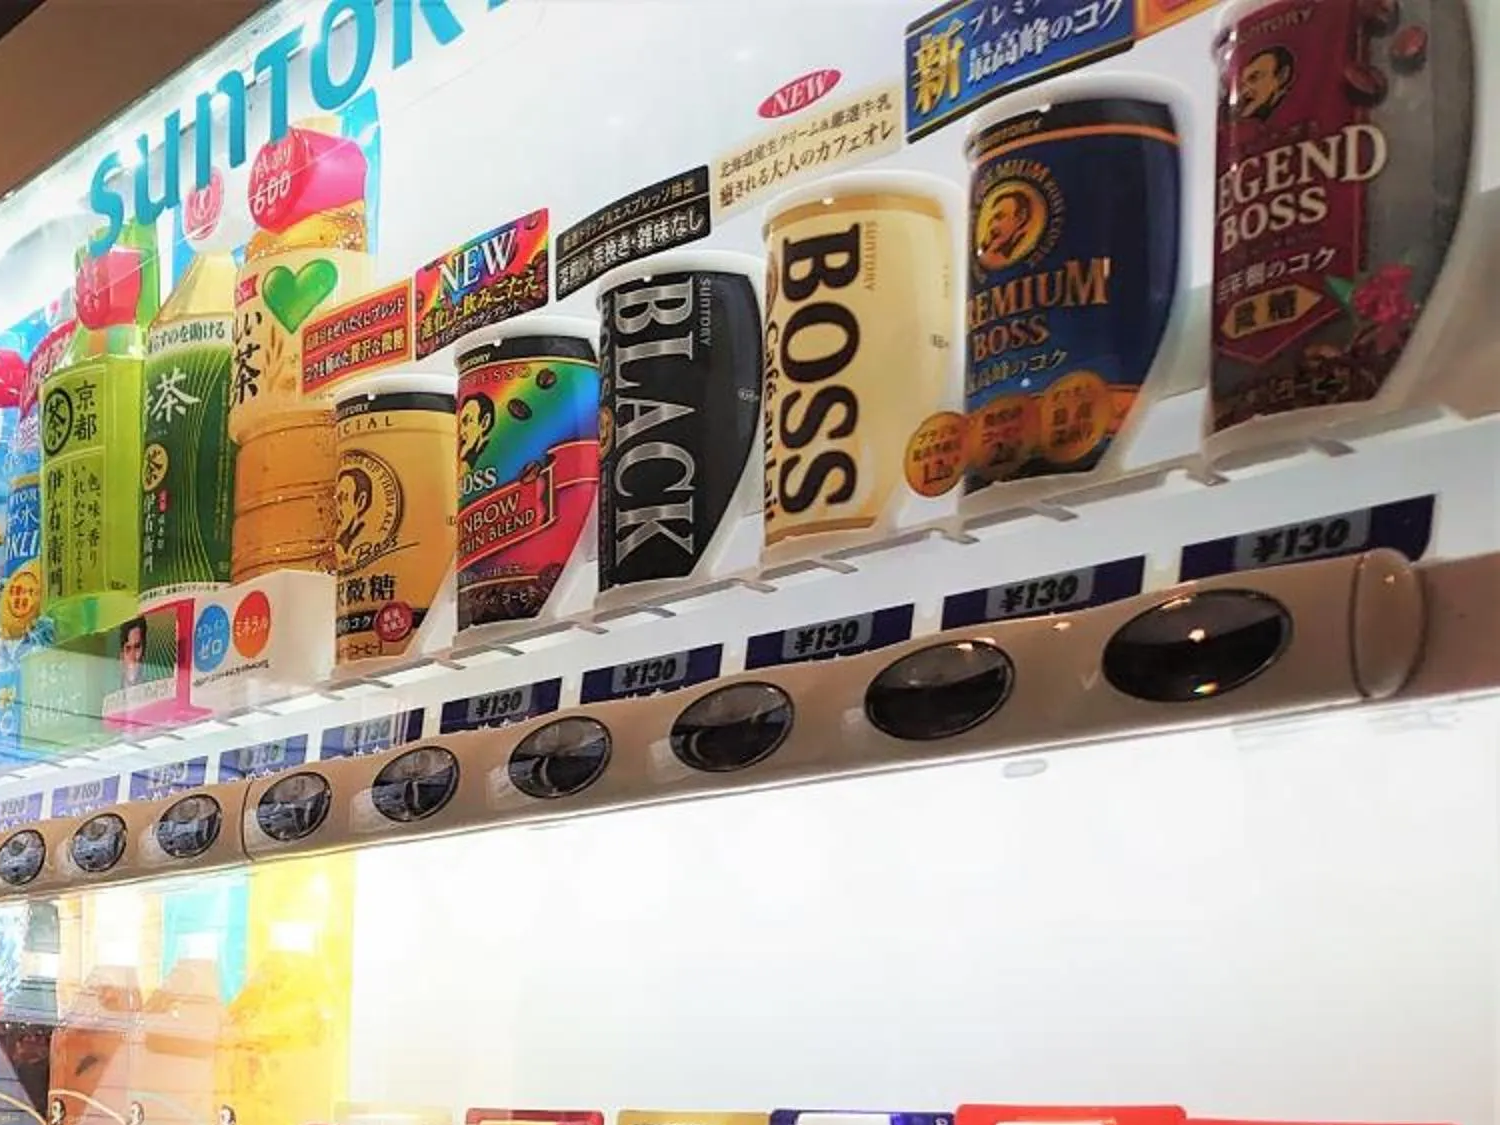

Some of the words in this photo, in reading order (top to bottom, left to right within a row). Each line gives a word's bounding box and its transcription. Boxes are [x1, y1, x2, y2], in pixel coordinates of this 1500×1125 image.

[771, 70, 835, 118] NEW
[912, 18, 966, 114] 新
[89, 0, 514, 257] SUNTOR
[718, 119, 896, 207] 癒される大人のカフェオレ
[1218, 123, 1388, 219] EGEND
[1219, 187, 1328, 253] BOSS
[439, 226, 518, 297] NEW
[700, 277, 713, 347] SUNTORY
[972, 313, 1050, 363] BOSS
[779, 222, 861, 517] BOSS
[72, 379, 98, 443] 京都
[614, 275, 697, 567] BLACK
[1250, 518, 1353, 566] ¥130
[999, 574, 1081, 616] ¥130
[793, 619, 860, 654] ¥130
[475, 691, 524, 720] ¥130
[621, 656, 678, 690] ¥130
[348, 716, 393, 748] ¥130
